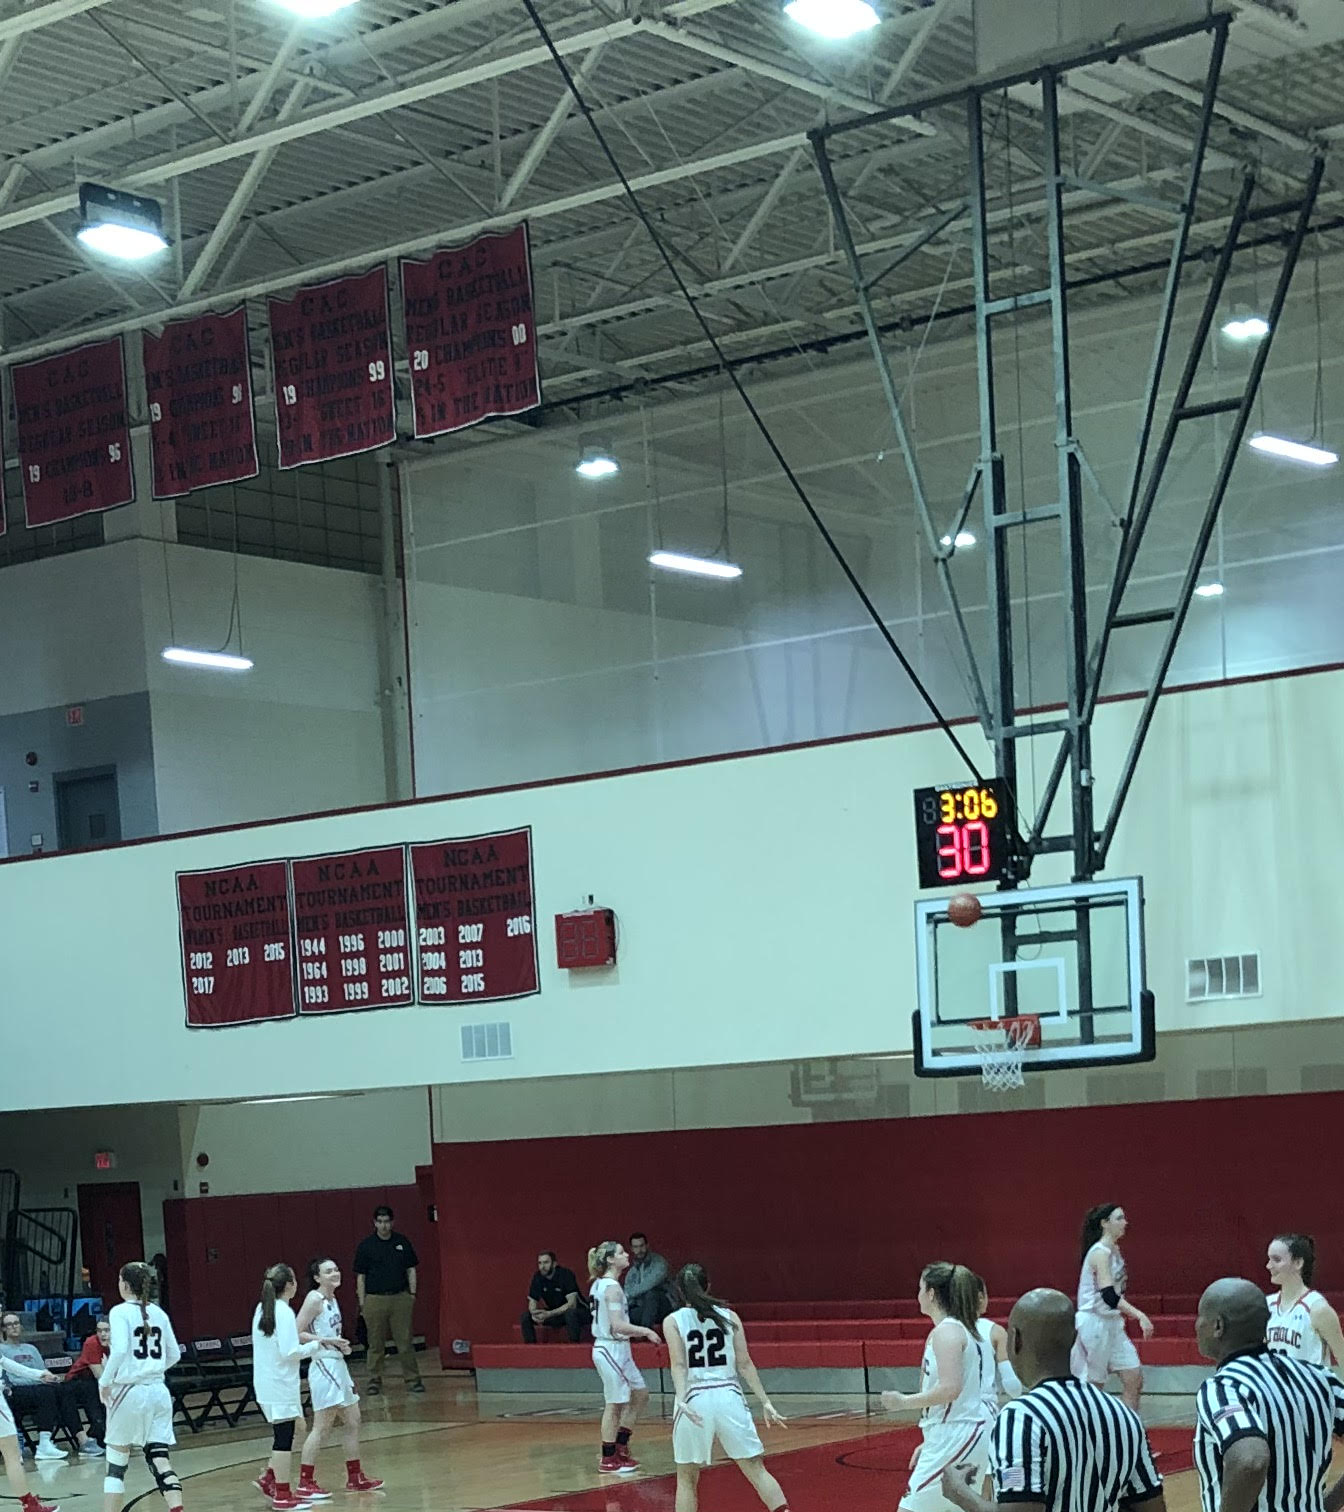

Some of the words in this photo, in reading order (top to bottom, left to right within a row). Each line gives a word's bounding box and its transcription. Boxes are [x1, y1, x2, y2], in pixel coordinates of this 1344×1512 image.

[413, 350, 429, 371] 20
[282, 384, 297, 406] 19
[368, 360, 386, 382] 99
[28, 464, 40, 483] 19
[940, 787, 998, 823] 3:06
[443, 843, 500, 868] NCAA
[937, 821, 991, 878] 30
[318, 858, 380, 883] NCAA
[417, 864, 528, 895] TOURNAMENT
[204, 874, 259, 898] NCAA
[296, 881, 404, 910] TOURNAMENT
[182, 895, 287, 922] TOURNAMENT
[300, 936, 327, 957] 1944
[338, 932, 366, 954] 1996
[377, 928, 405, 949] 2000
[419, 925, 446, 946] 2003
[458, 922, 484, 944] 2007
[506, 916, 531, 937] 2016
[189, 951, 214, 970] 2012
[226, 946, 251, 968] 2013
[263, 942, 286, 962] 2015
[302, 961, 328, 980] 1964
[340, 956, 367, 977] 1998
[379, 952, 405, 973] 2001
[422, 951, 447, 971] 2004
[459, 948, 484, 969] 2013
[191, 976, 215, 995] 2017
[304, 984, 329, 1004] 1993
[343, 981, 369, 1001] 1999
[381, 976, 410, 997] 2002
[423, 976, 448, 994] 2006
[461, 972, 486, 993] 2015
[133, 1326, 163, 1360] 33
[687, 1328, 727, 1368] 22
[1267, 1326, 1302, 1349] THOLIC
